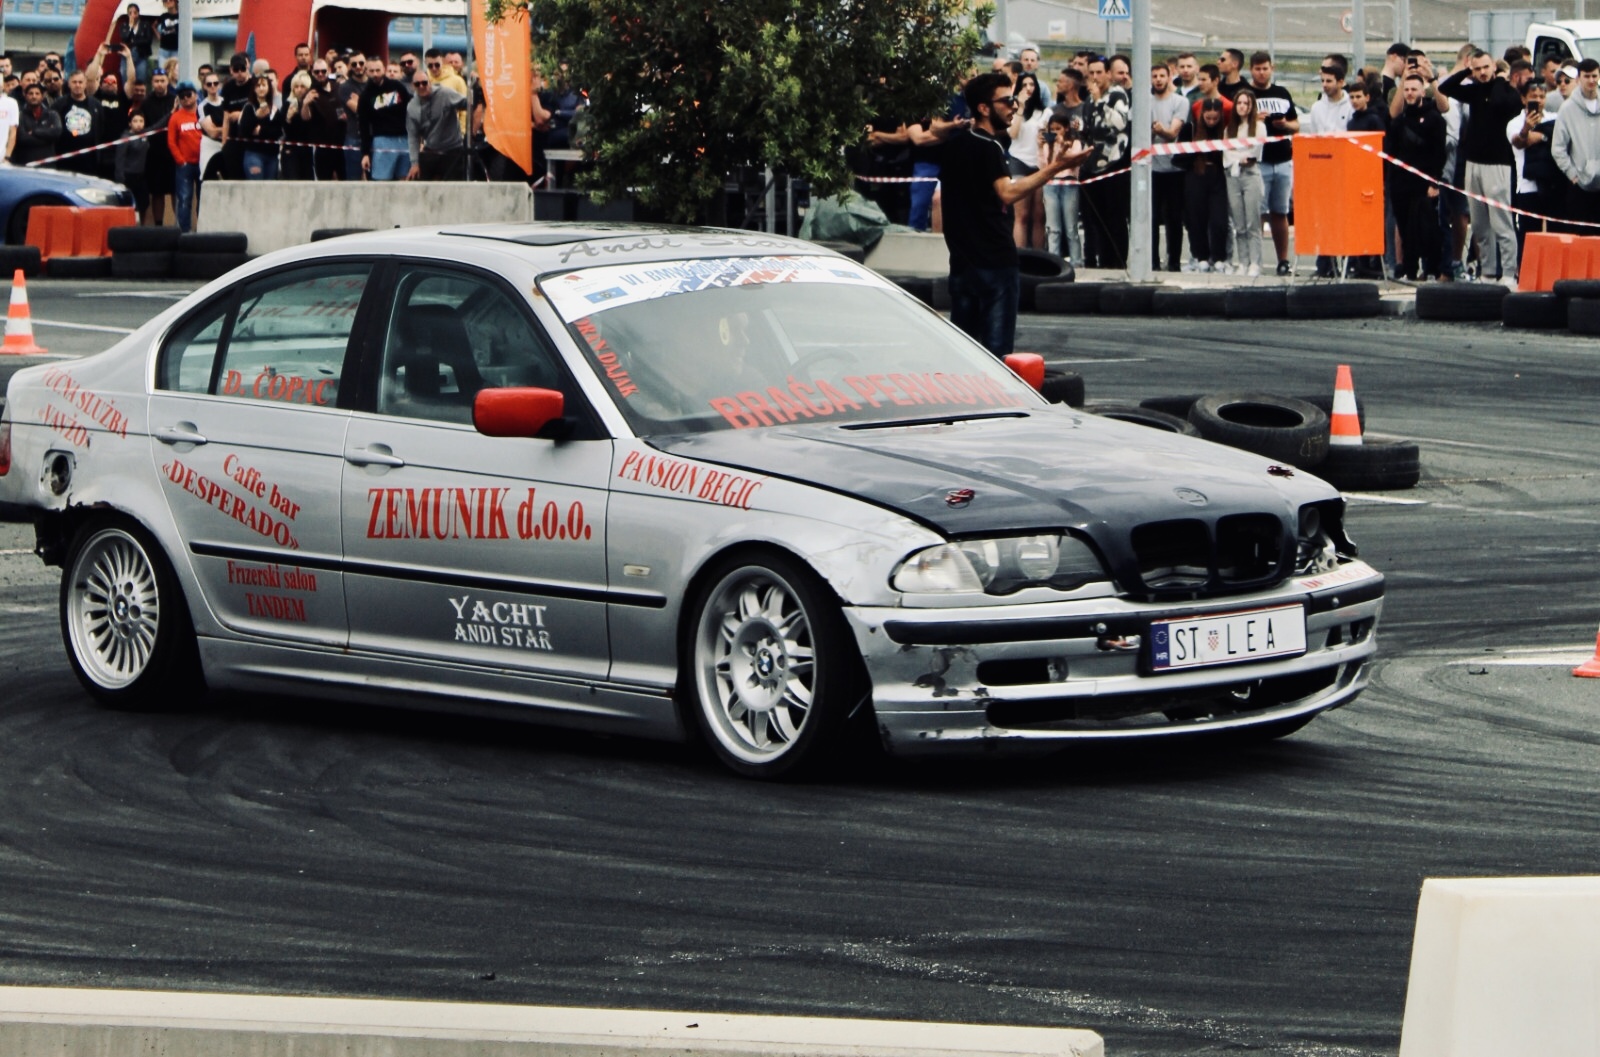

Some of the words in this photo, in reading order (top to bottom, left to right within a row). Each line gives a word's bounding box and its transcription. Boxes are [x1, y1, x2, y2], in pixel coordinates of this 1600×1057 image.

[598, 351, 640, 399] DAJAK
[75, 391, 129, 440] SLUŽBA
[709, 374, 848, 430] BRAĆA
[223, 454, 266, 498] Caffe
[269, 484, 301, 521] bar
[617, 450, 704, 495] PANSION
[366, 487, 511, 540] ZEMUNIK
[516, 487, 592, 541] d.o.o.
[226, 560, 281, 589] Frizerski
[284, 566, 317, 592] salon
[245, 593, 307, 622] TANDEM
[448, 595, 547, 627] YACHT
[454, 623, 499, 645] ANDI
[501, 627, 554, 650] STAR
[1155, 651, 1168, 660] HR
[1175, 627, 1199, 661] ST
[1226, 617, 1276, 655] LEA
